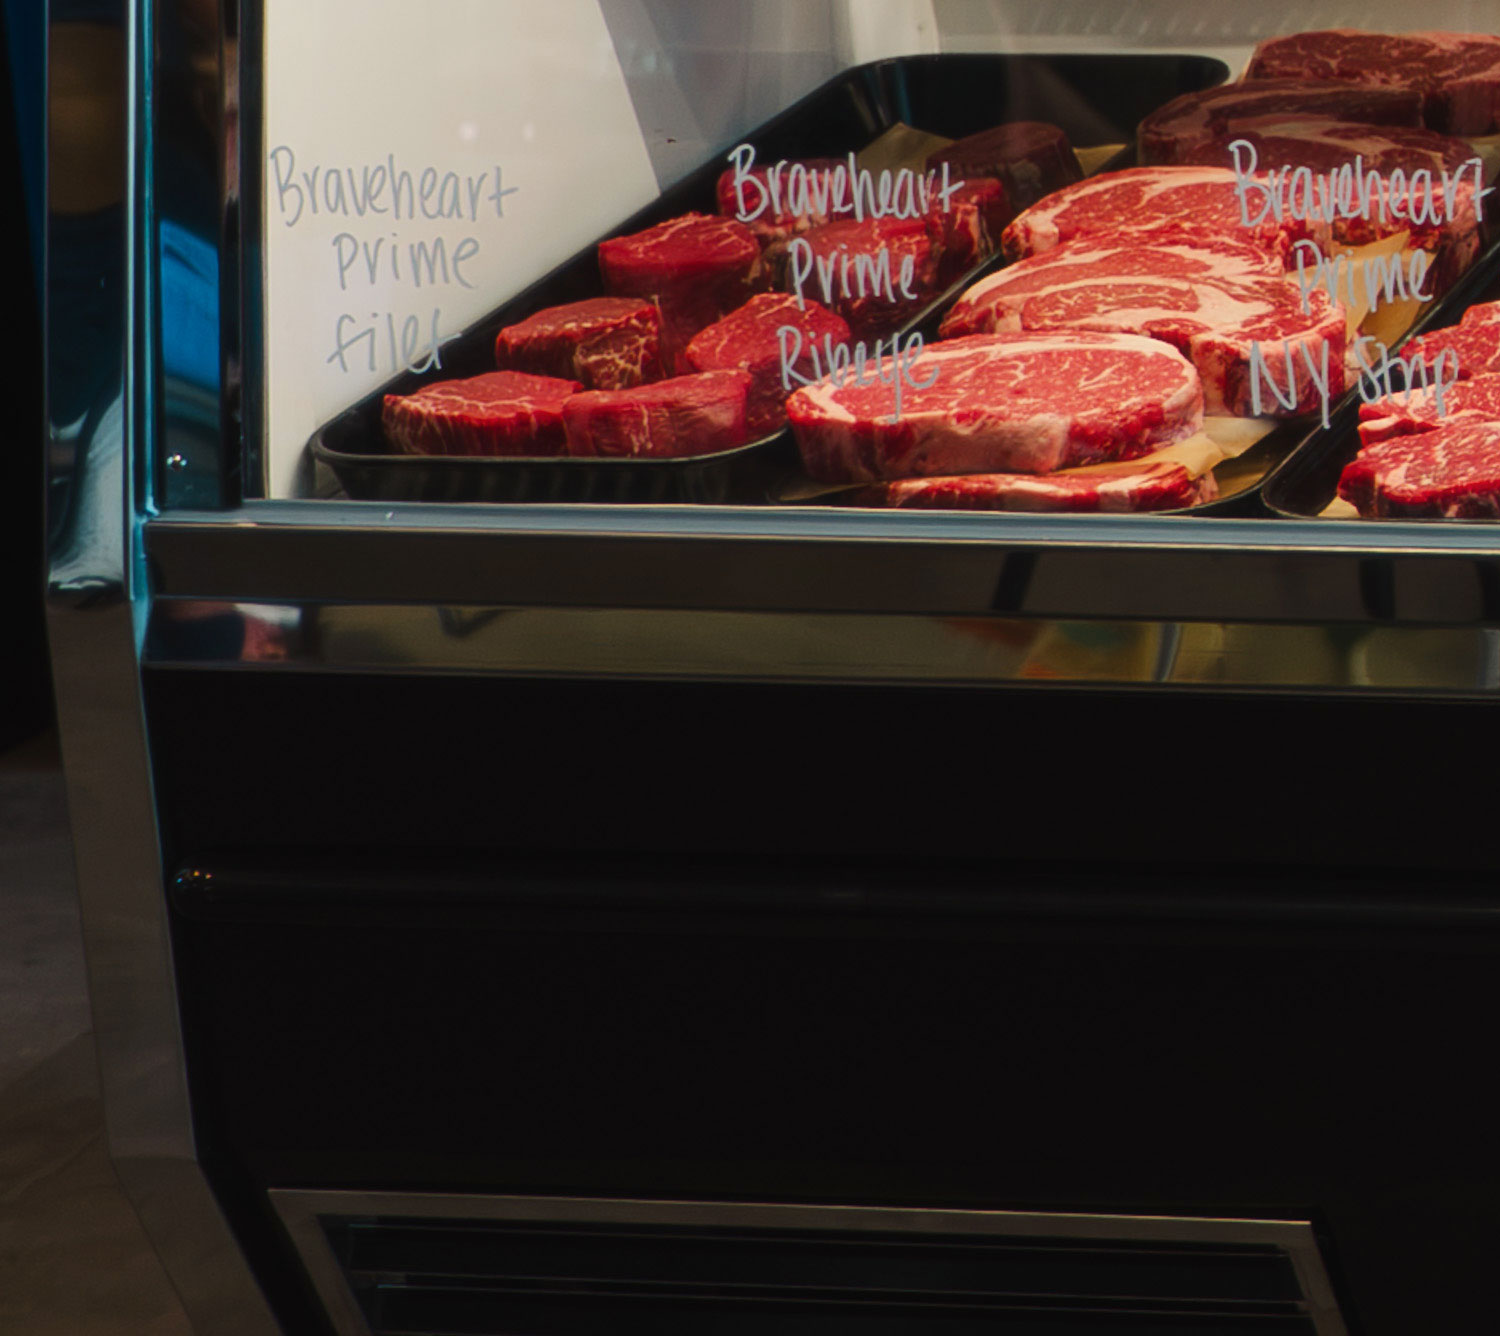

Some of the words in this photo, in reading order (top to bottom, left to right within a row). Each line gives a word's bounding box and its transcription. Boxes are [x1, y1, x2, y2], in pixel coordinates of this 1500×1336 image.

[270, 144, 520, 228] Braveheart
[727, 142, 966, 223] Braveheart
[1227, 138, 1497, 227] Braveheart
[787, 237, 919, 312] Prime
[1293, 238, 1434, 315] Prime
[776, 324, 941, 426] Ribeye
[1247, 339, 1332, 430] NY
[1353, 335, 1461, 418] Strip
